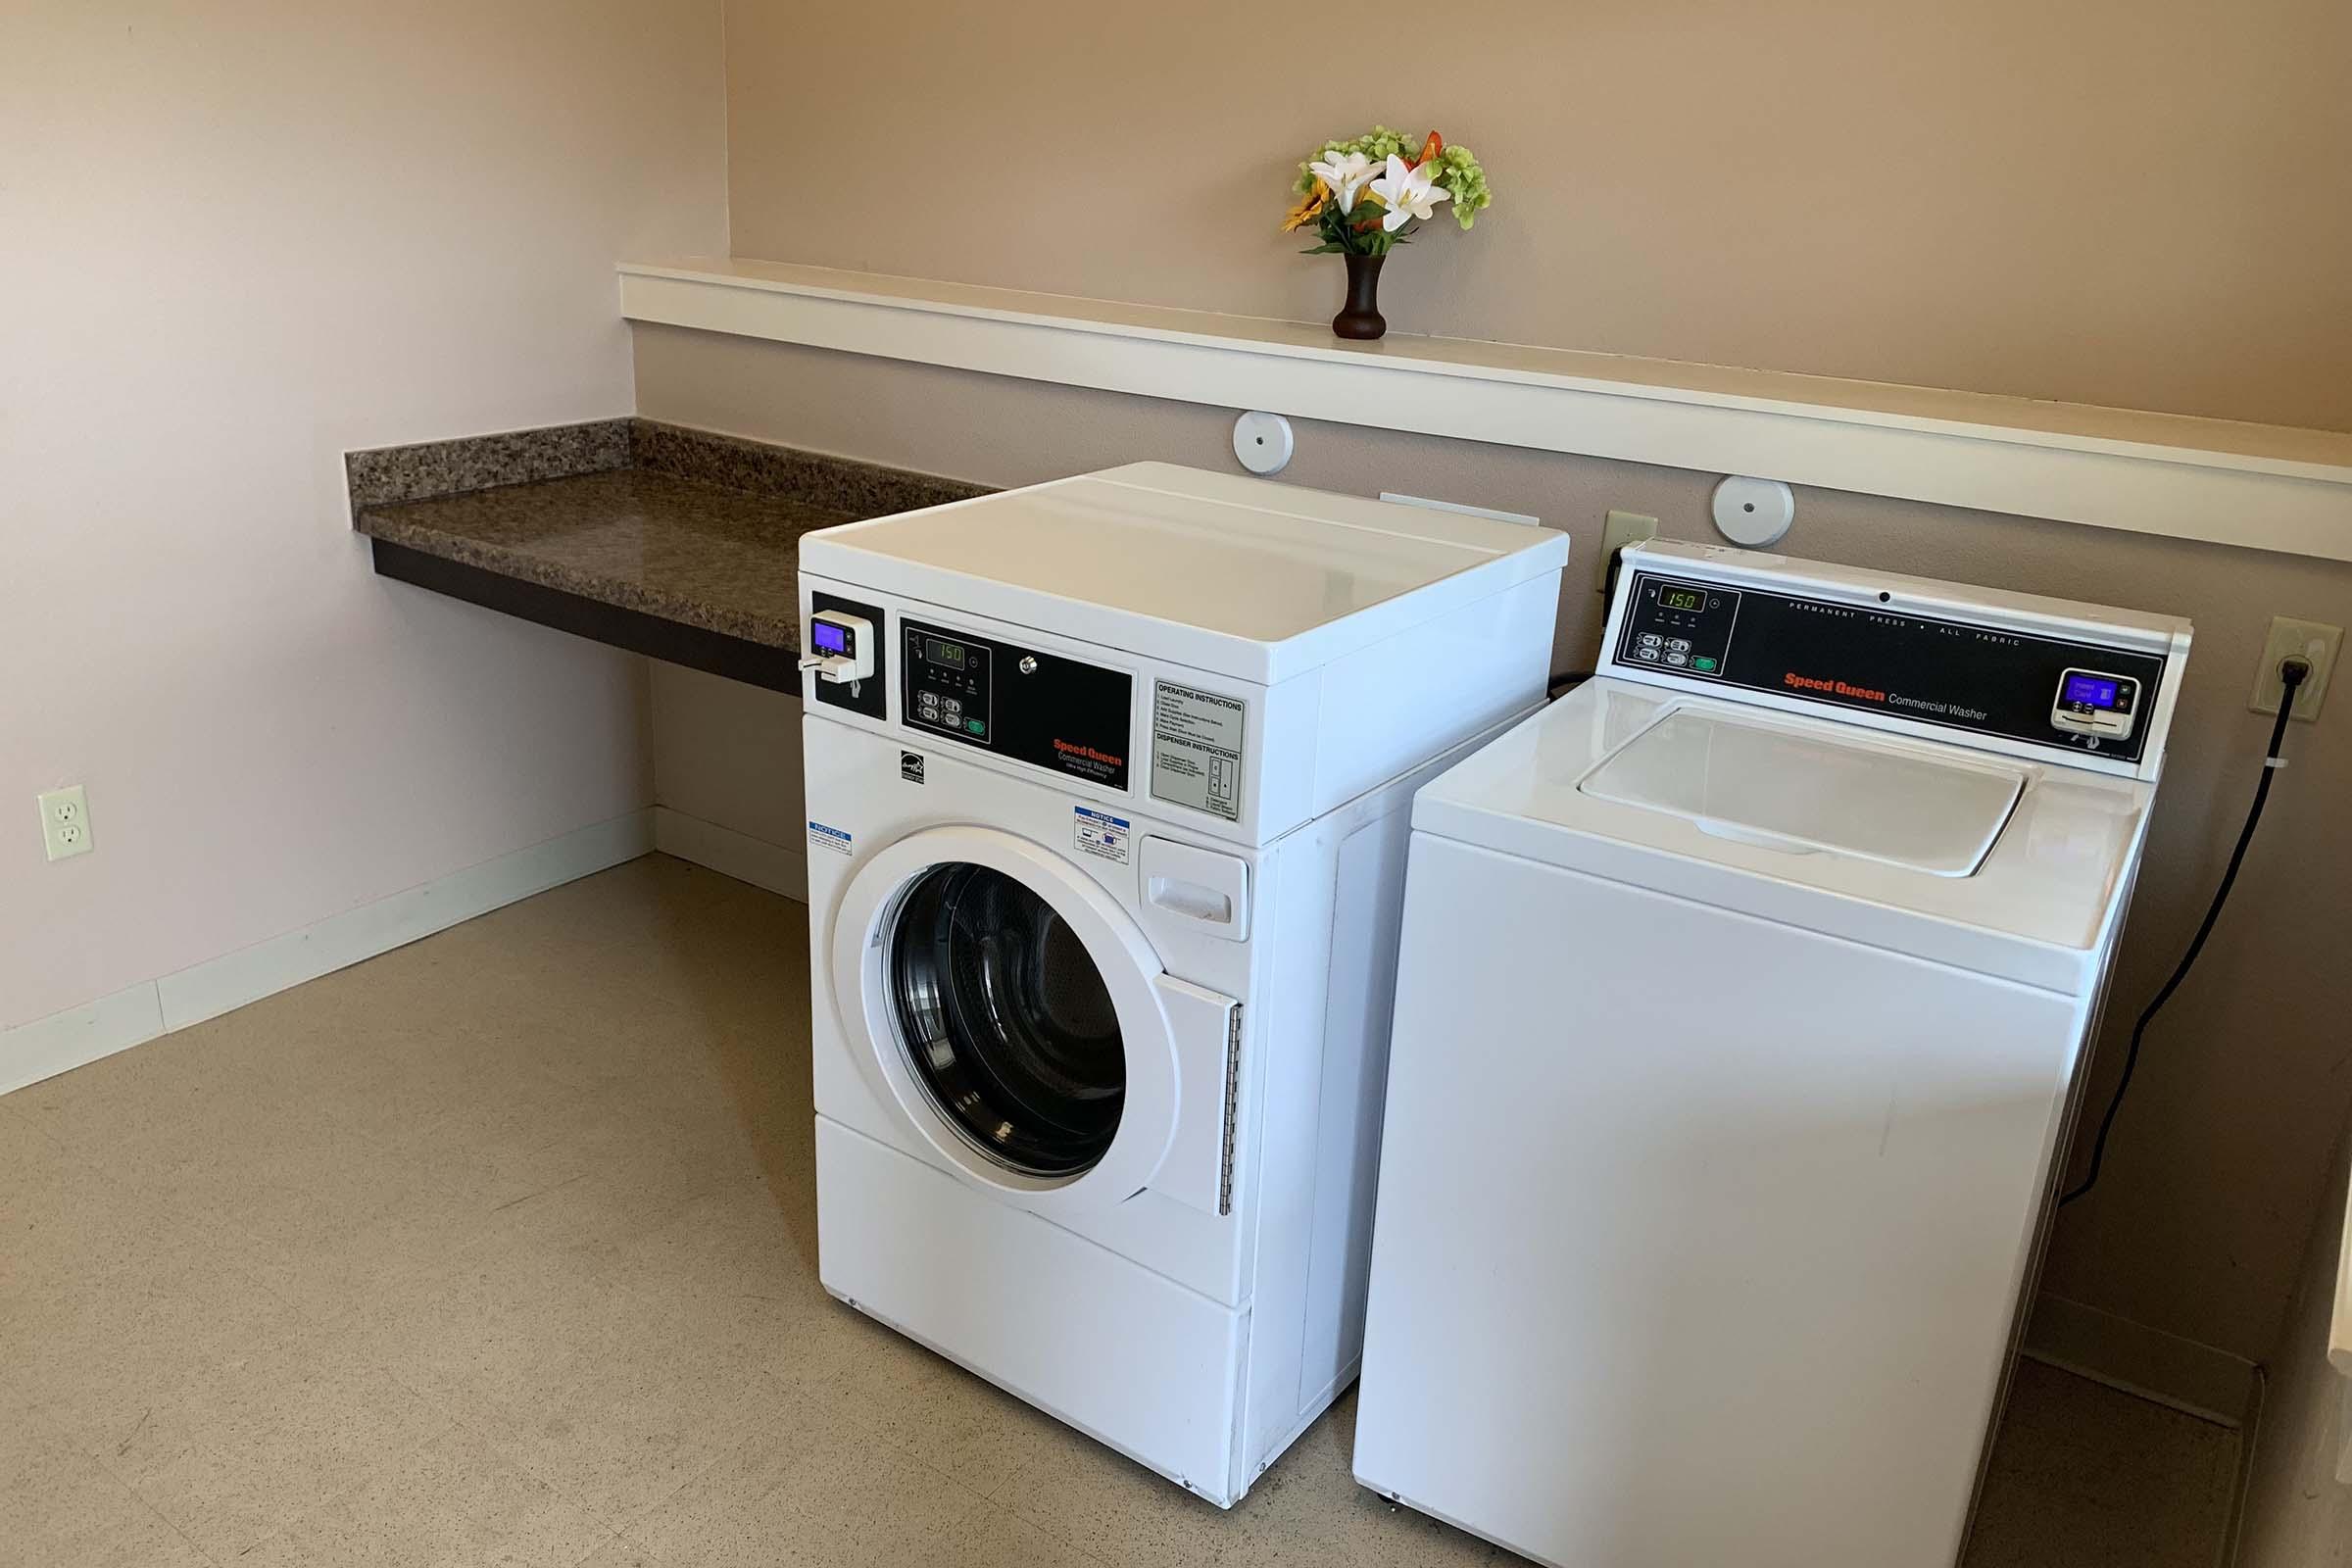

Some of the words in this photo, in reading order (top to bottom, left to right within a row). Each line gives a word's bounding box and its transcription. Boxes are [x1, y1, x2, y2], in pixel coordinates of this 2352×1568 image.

[1669, 593, 1695, 608] 150
[1788, 602, 1856, 618] PERMANENT
[1869, 615, 1906, 627] PRESS
[1939, 626, 1960, 636] ALL
[1976, 633, 2020, 646] FABRIC
[942, 644, 961, 661] 150
[1158, 684, 1195, 699] OPERATING
[1195, 693, 1242, 711] INSTRUCTIONS
[1784, 672, 1835, 692] Speed
[1835, 681, 1886, 702] Queen
[1888, 693, 1946, 713] Commercial
[1949, 704, 1987, 721] Washer
[1054, 738, 1087, 757] Speed
[1088, 747, 1122, 766] Queen
[1156, 733, 1192, 748] DISPENSER
[1192, 742, 1239, 760] INSTRUCTIONS
[1057, 751, 1093, 767] Commercial
[1093, 760, 1115, 774] Washer
[1091, 811, 1114, 823] NOTICE
[814, 823, 846, 840] NOTICE
